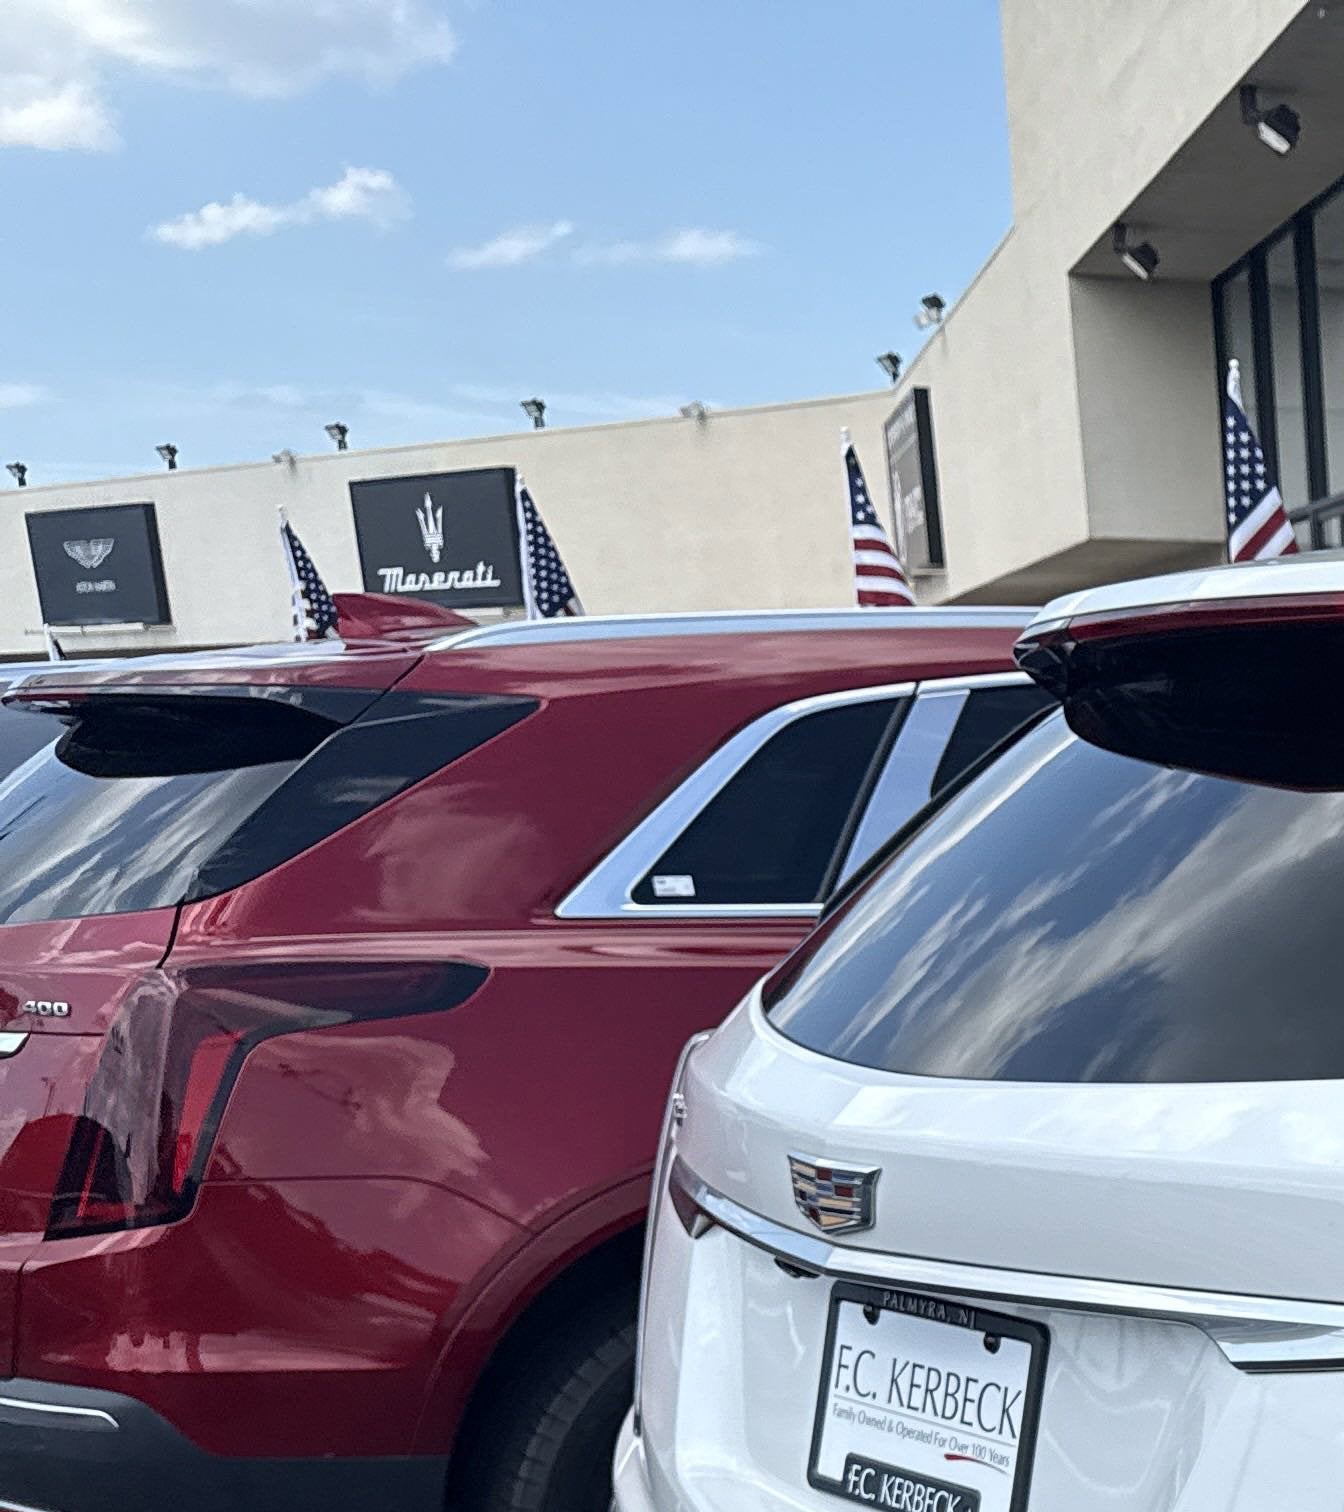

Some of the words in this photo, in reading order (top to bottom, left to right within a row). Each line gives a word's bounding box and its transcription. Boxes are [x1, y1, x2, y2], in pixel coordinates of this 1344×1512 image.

[376, 560, 502, 593] Maserati
[22, 1001, 71, 1017] 400
[882, 1290, 952, 1323] PALMYRA,
[834, 1344, 877, 1401] F.C.
[887, 1357, 1023, 1440] KERBECK
[832, 1402, 857, 1425] Family
[857, 1409, 888, 1432] Owned
[886, 1418, 894, 1433] &
[895, 1421, 934, 1445] Operated
[934, 1431, 948, 1449] For
[948, 1436, 969, 1455] Over
[971, 1443, 987, 1461] 100
[989, 1447, 1011, 1468] Years
[847, 1464, 877, 1501] F.C.
